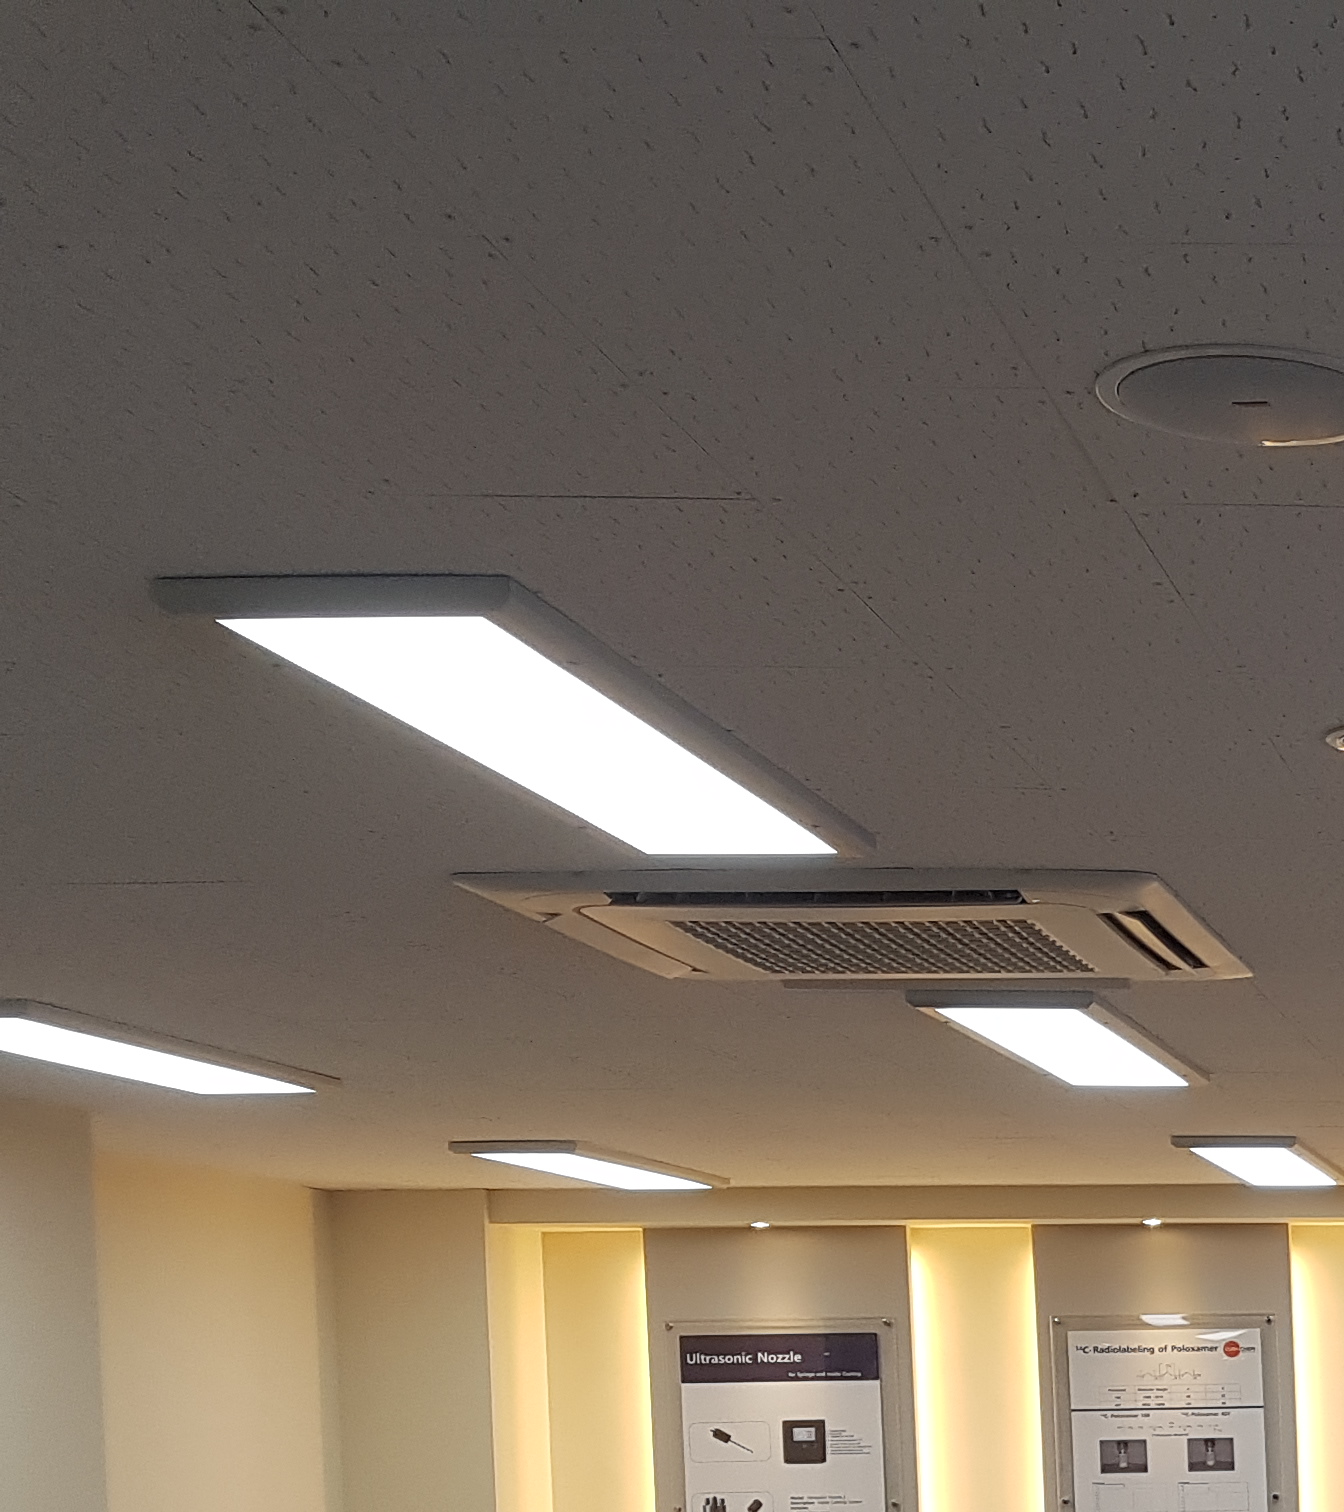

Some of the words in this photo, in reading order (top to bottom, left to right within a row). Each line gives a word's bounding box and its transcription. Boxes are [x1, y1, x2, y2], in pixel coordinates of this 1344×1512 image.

[1158, 1345, 1168, 1353] of
[1171, 1345, 1219, 1353] Poloxamer
[686, 1351, 753, 1365] Ultrasonic
[757, 1350, 802, 1364] Nozzle
